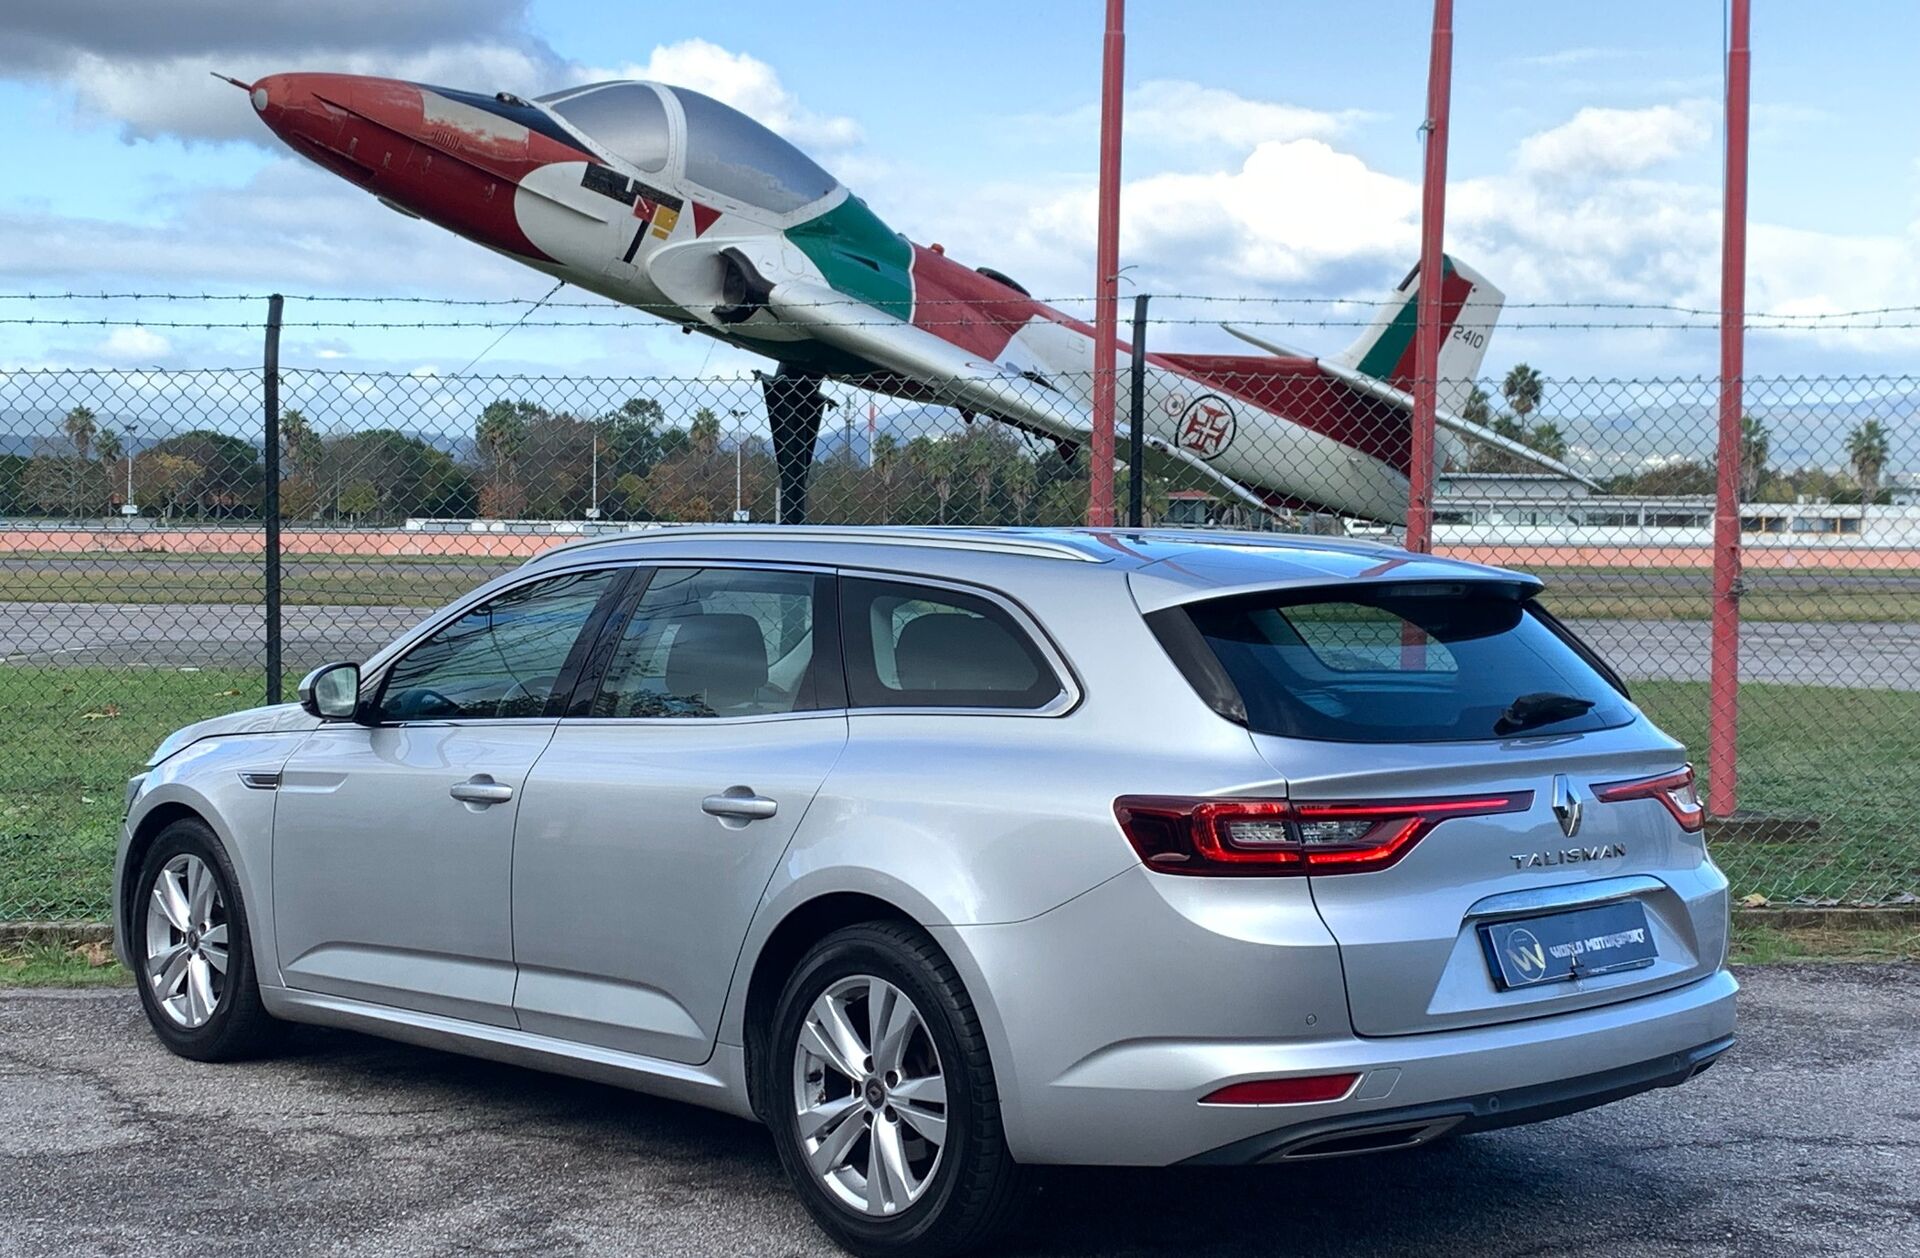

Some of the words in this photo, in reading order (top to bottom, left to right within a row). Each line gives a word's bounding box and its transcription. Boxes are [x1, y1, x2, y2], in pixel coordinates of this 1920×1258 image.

[1453, 325, 1484, 348] 2410
[1510, 843, 1626, 869] TALISMAN
[1549, 941, 1584, 958] WORLD
[1585, 928, 1644, 950] MOTORSPORT
